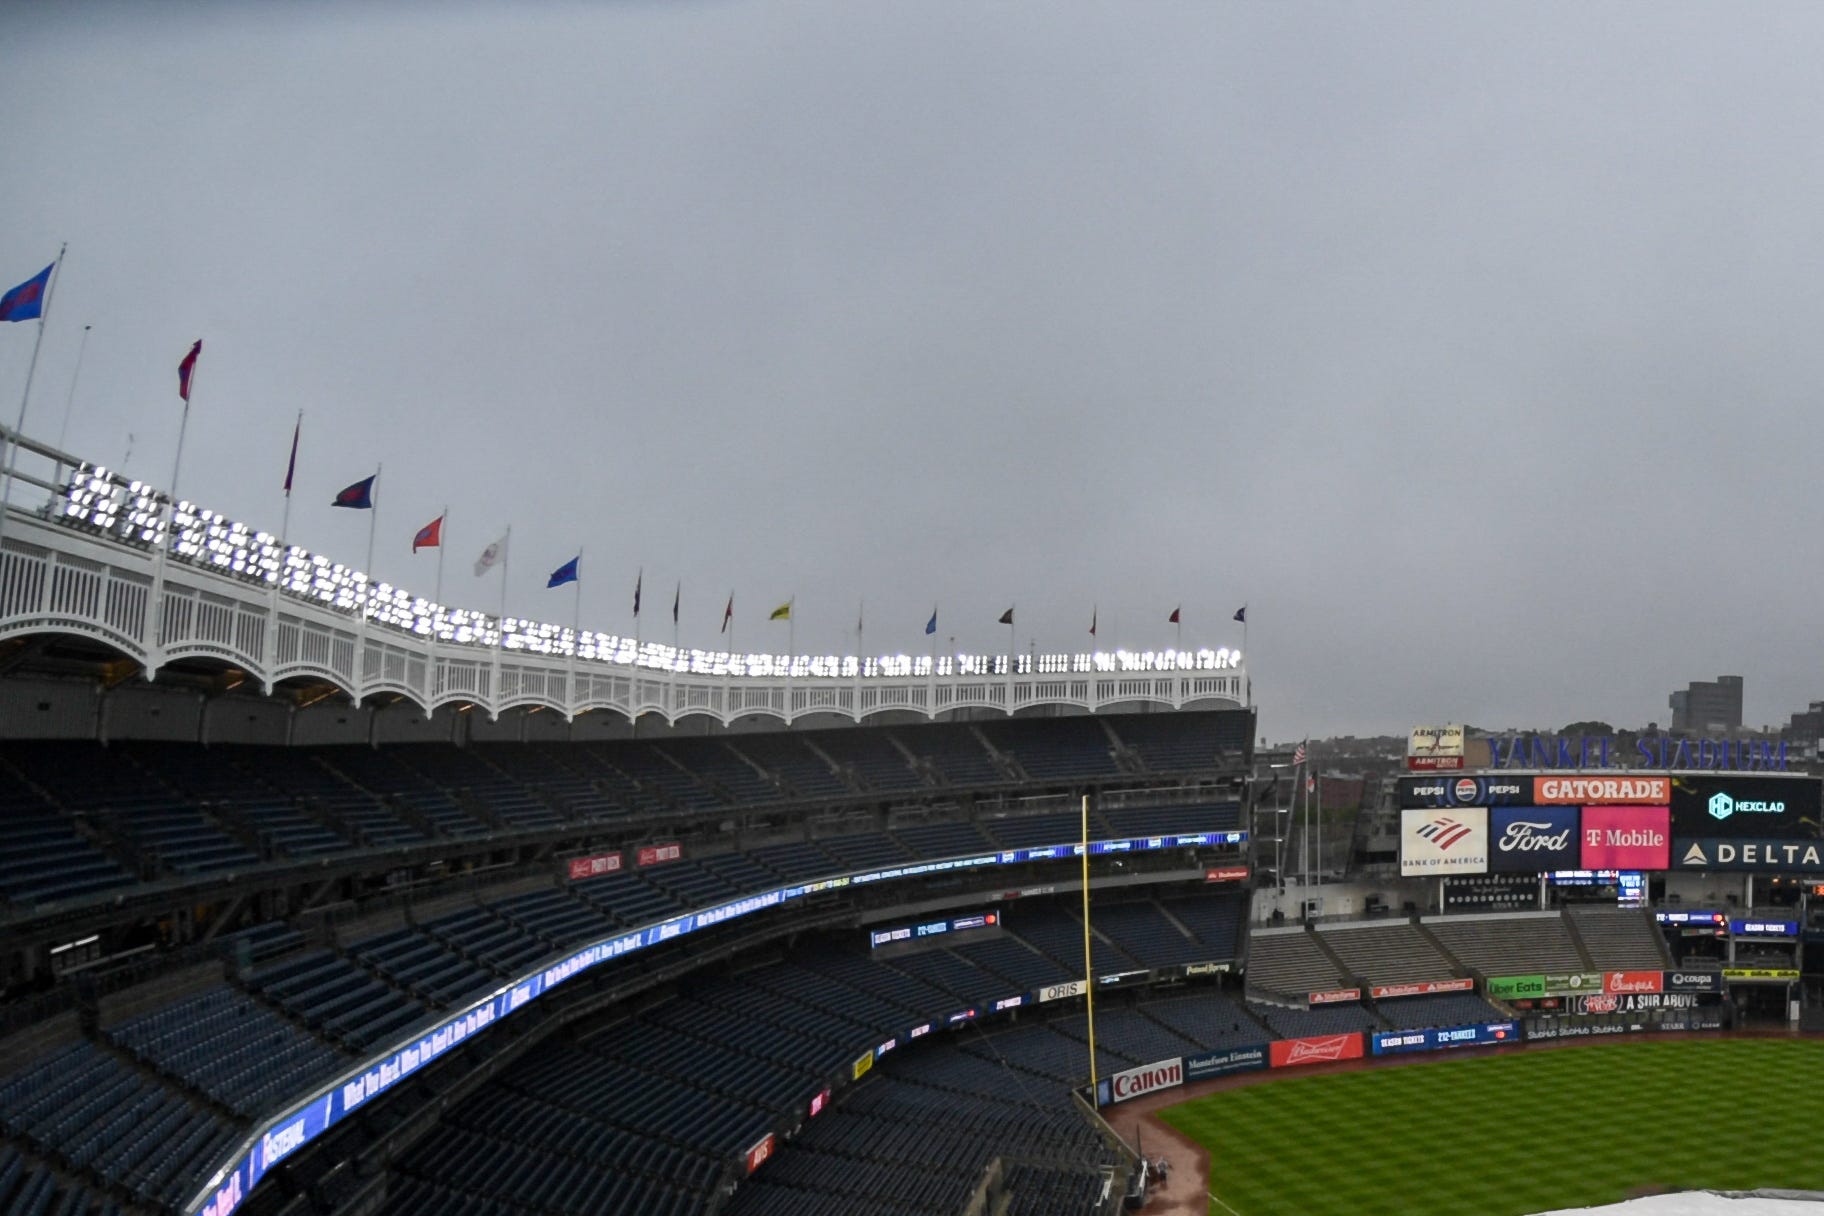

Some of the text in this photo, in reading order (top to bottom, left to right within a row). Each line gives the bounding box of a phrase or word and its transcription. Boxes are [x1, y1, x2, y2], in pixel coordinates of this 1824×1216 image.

[1413, 729, 1461, 737] ARMITRON
[1488, 736, 1788, 770] YANKEE STADIUM
[1413, 787, 1444, 796] PEPSI
[1489, 785, 1520, 794] PEPSI
[1542, 780, 1664, 799] GATORADE
[1735, 801, 1784, 812] HEXCLAD
[1499, 821, 1570, 851] Ford
[1606, 829, 1664, 846] Mobile
[1718, 844, 1821, 864] DELTA
[1402, 857, 1485, 867] BANK OF AMERICA
[1516, 979, 1542, 992] Eats
[1684, 975, 1712, 983] coupa
[1048, 983, 1078, 999] ORIS
[1626, 996, 1634, 1010] A
[1559, 1027, 1590, 1036] StubHub
[1592, 1024, 1624, 1033] StubHub
[1188, 1051, 1262, 1069] Montefiore Einstein
[1115, 1063, 1181, 1098] Canon
